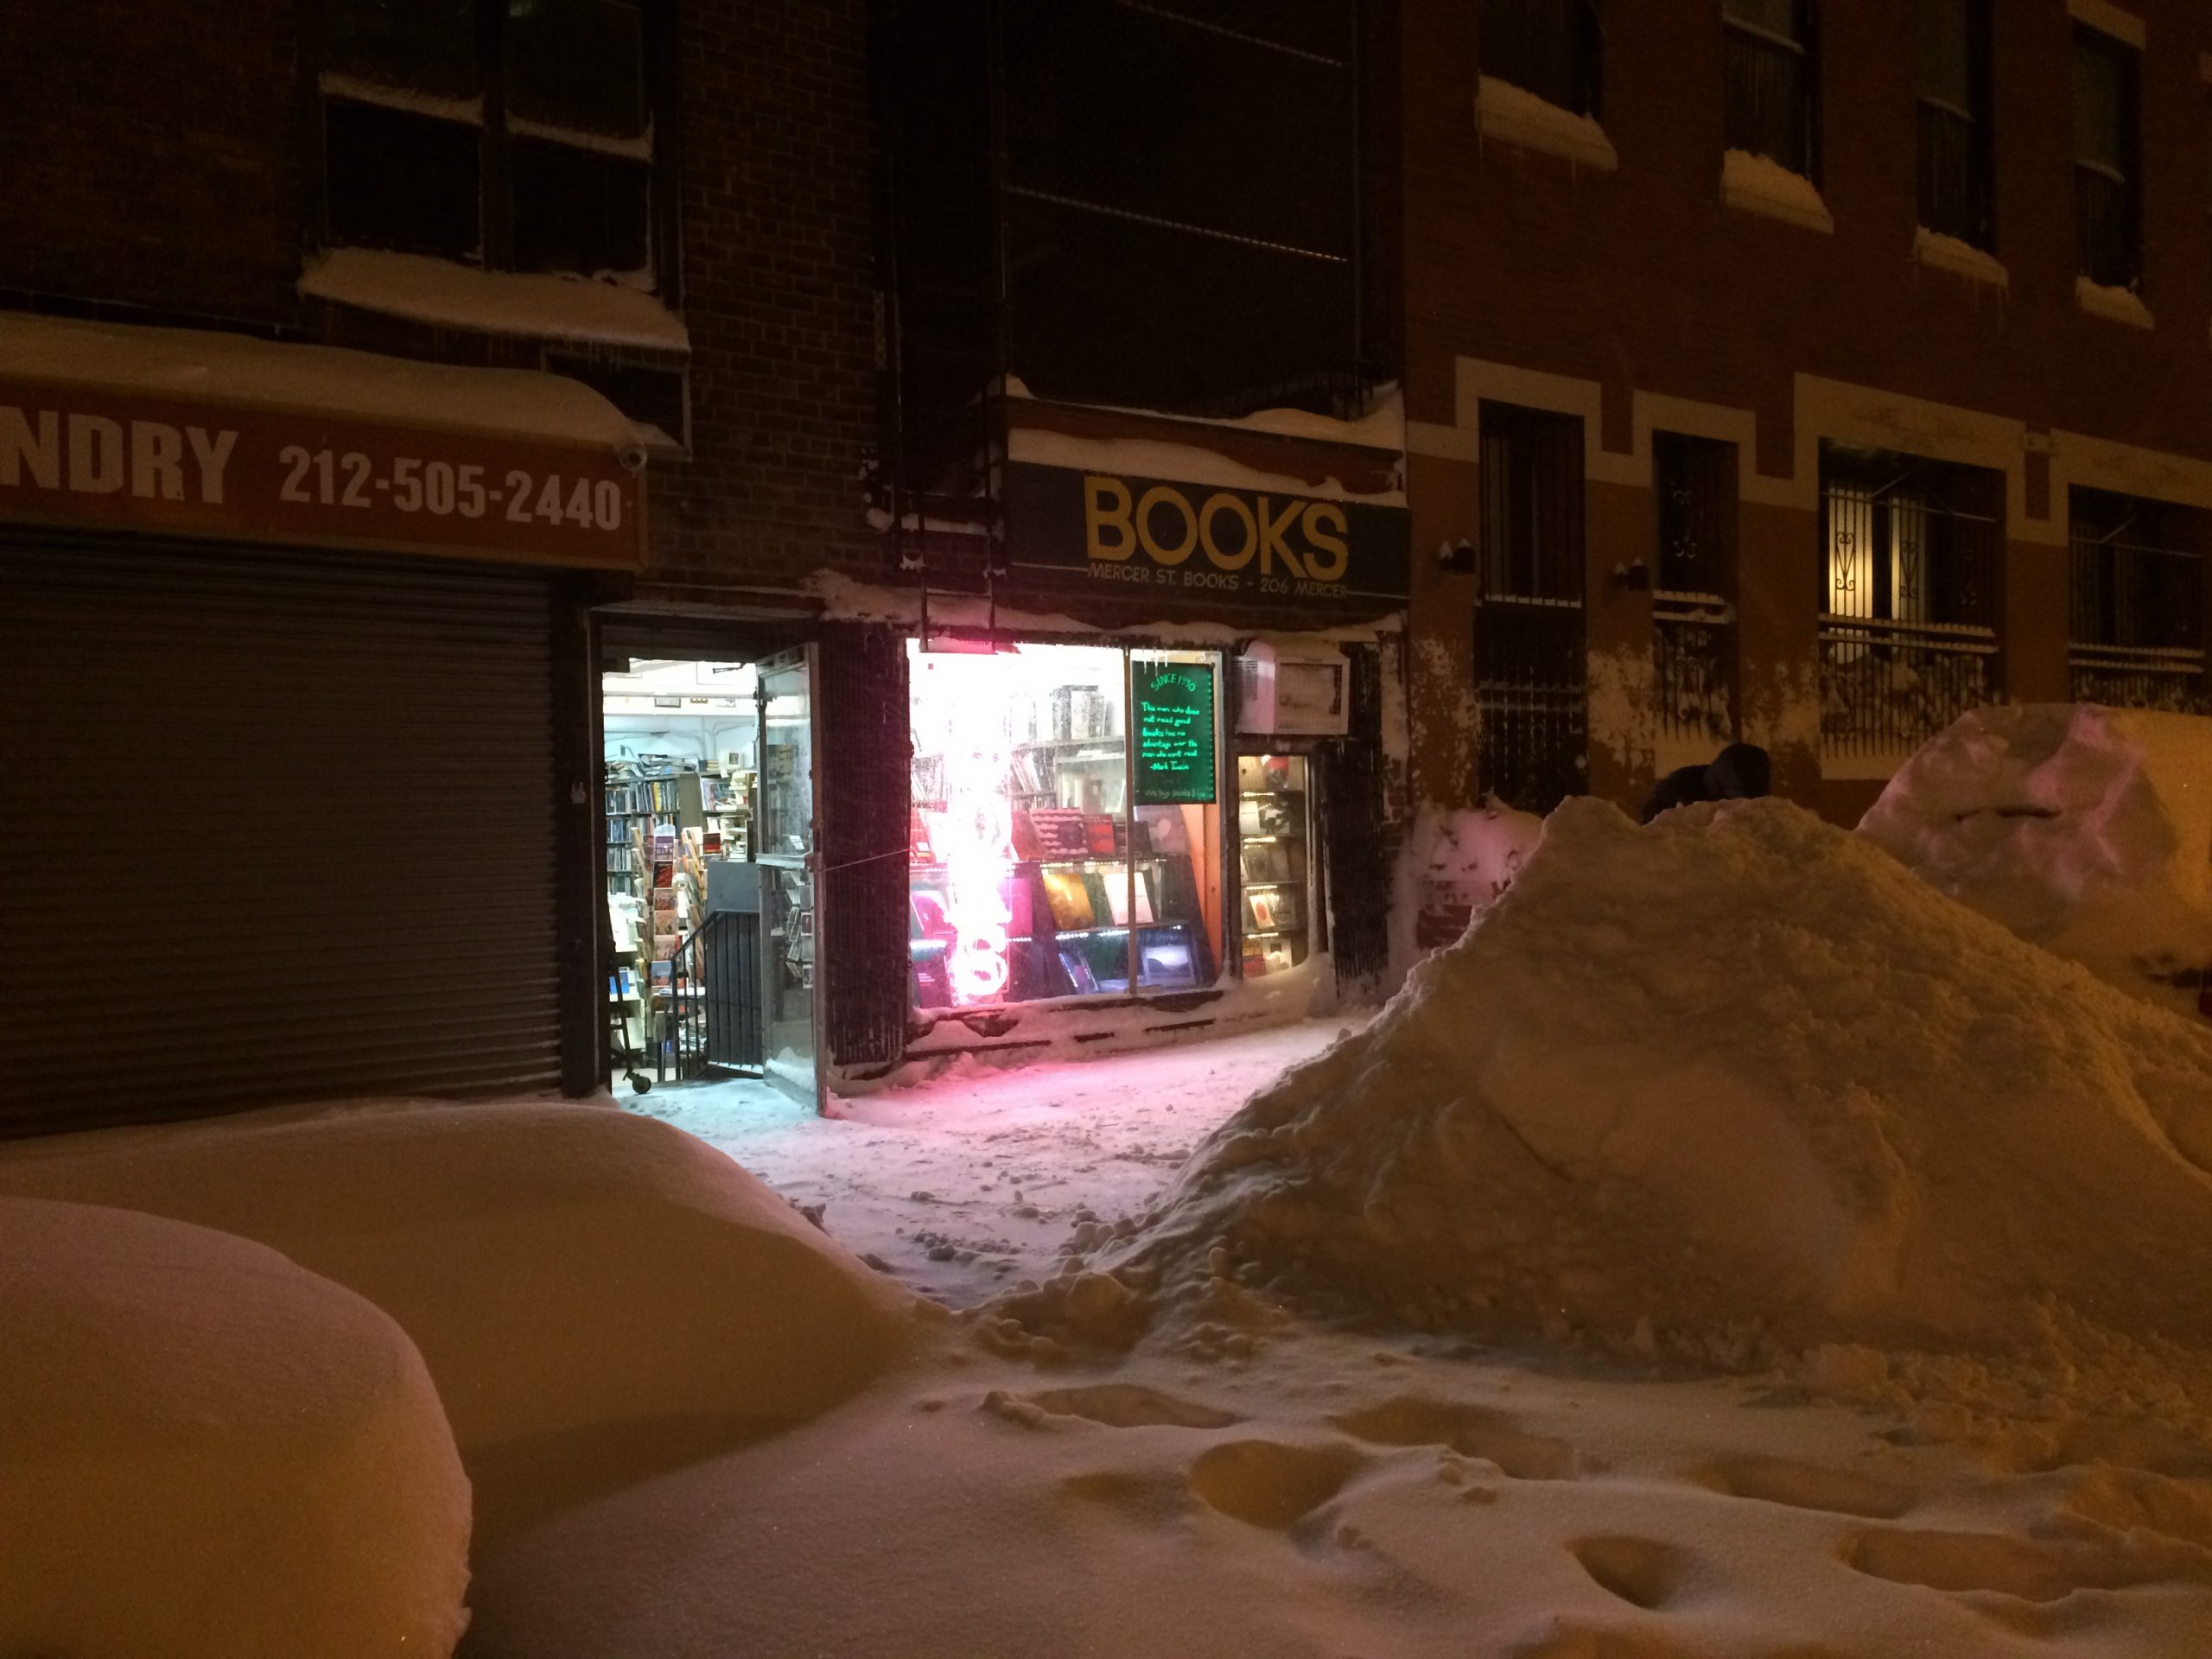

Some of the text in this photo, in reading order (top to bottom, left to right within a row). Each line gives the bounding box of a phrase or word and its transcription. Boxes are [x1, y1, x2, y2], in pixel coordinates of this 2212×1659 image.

[0, 406, 622, 531] NDRY 212-505-2440
[1084, 476, 1349, 582] BOOKS
[1088, 563, 1149, 583] MERCER
[1156, 569, 1177, 586] ST.
[1184, 571, 1239, 590] BOOKS
[1261, 577, 1288, 594] 206
[1296, 582, 1348, 599] MERCER
[1150, 674, 1196, 692] SINCE 1990
[1141, 702, 1155, 712] The
[1185, 706, 1200, 715] does
[1143, 715, 1154, 723] not
[1174, 716, 1191, 727] good
[1142, 727, 1164, 737] books
[1165, 728, 1175, 737] has
[1142, 739, 1171, 750] advantage
[1188, 739, 1198, 747] the
[1170, 760, 1190, 771] Twain
